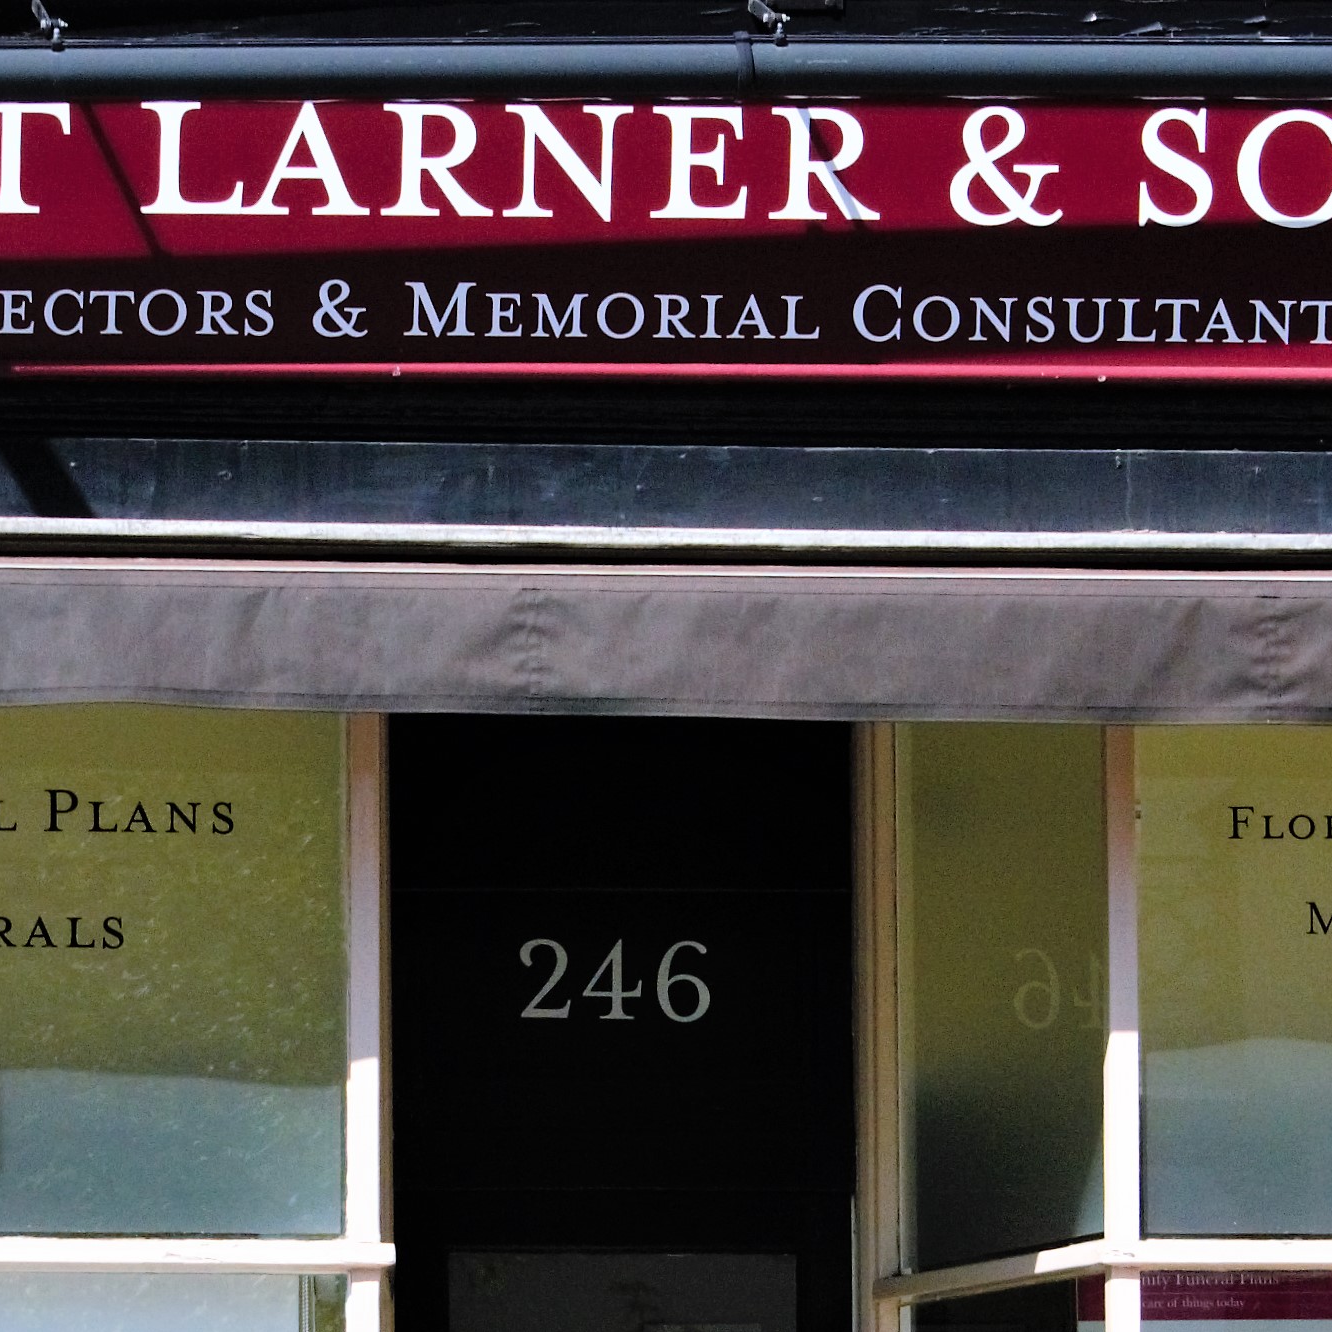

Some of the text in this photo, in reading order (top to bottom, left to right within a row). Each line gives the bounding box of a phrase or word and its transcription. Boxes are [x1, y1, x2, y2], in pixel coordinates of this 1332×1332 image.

[140, 102, 881, 223] LARNER
[949, 105, 1064, 227] &
[312, 278, 368, 338] &
[403, 281, 820, 340] MEMORIAL
[44, 789, 236, 836] PLANS
[519, 938, 711, 1023] 246
